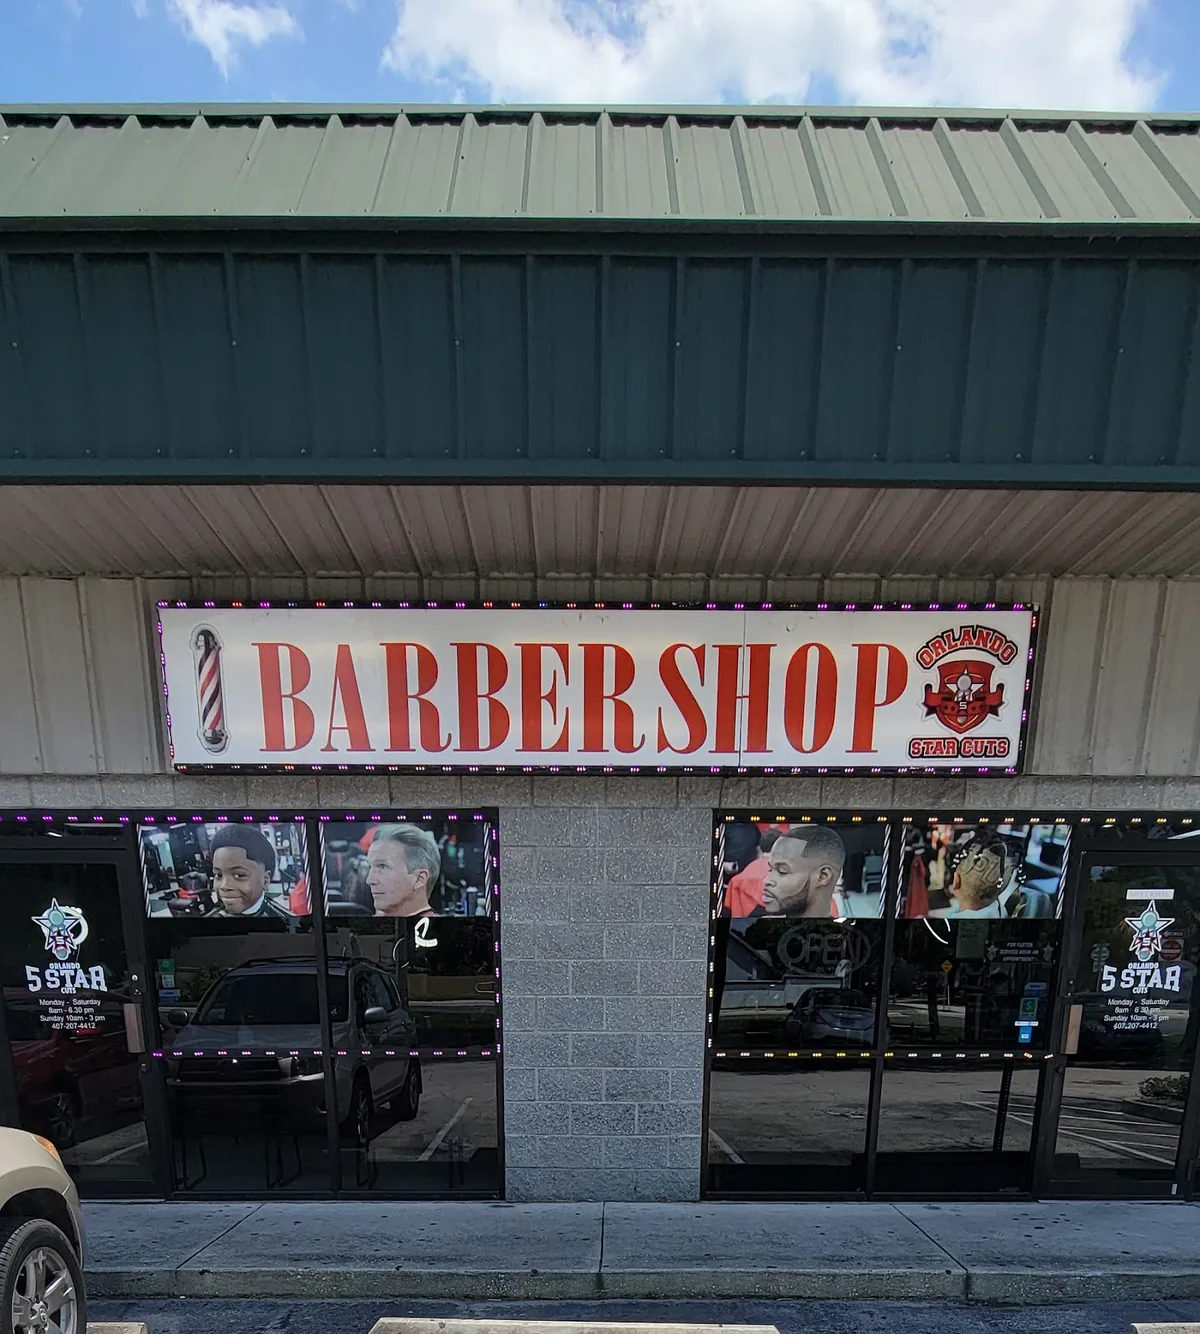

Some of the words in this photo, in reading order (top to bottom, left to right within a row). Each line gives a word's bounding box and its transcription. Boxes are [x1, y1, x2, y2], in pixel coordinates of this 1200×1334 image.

[918, 627, 1016, 668] ORLANDO
[911, 738, 958, 756] STAR
[961, 738, 1008, 756] CUTS
[25, 965, 42, 992] 5
[45, 965, 108, 992] STAR
[1101, 965, 1117, 992] 5
[1120, 965, 1181, 992] STAR
[39, 999, 64, 1007] Monday
[73, 998, 100, 1007] Saturday
[1141, 998, 1170, 1006] Saturday
